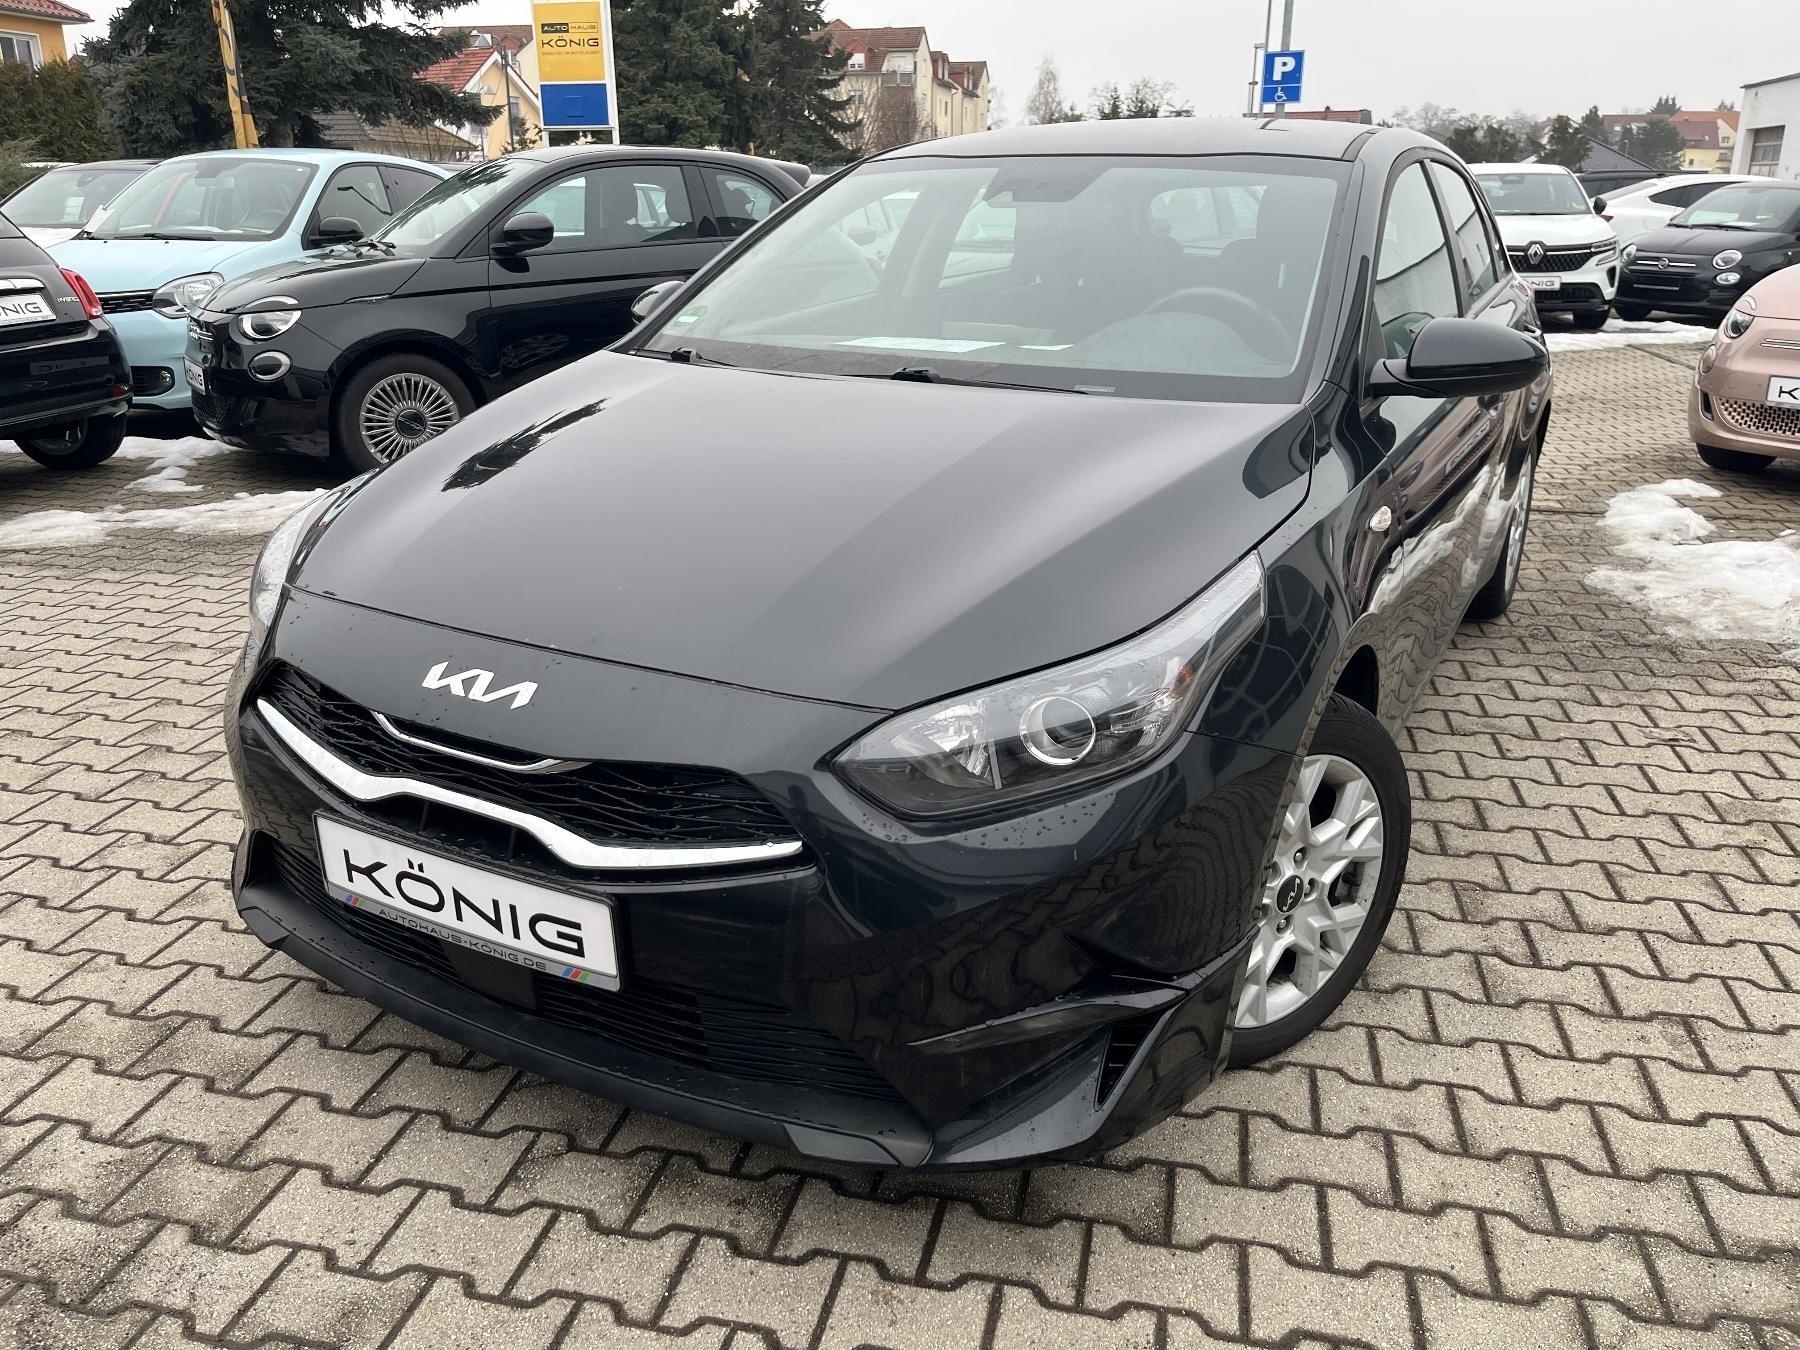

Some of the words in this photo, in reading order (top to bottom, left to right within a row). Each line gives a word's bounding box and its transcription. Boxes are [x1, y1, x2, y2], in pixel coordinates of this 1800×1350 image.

[541, 35, 599, 48] KÖNIG
[1272, 56, 1296, 81] P
[0, 302, 43, 317] NIG
[421, 661, 539, 710] KIA
[343, 848, 586, 958] KÖNIG
